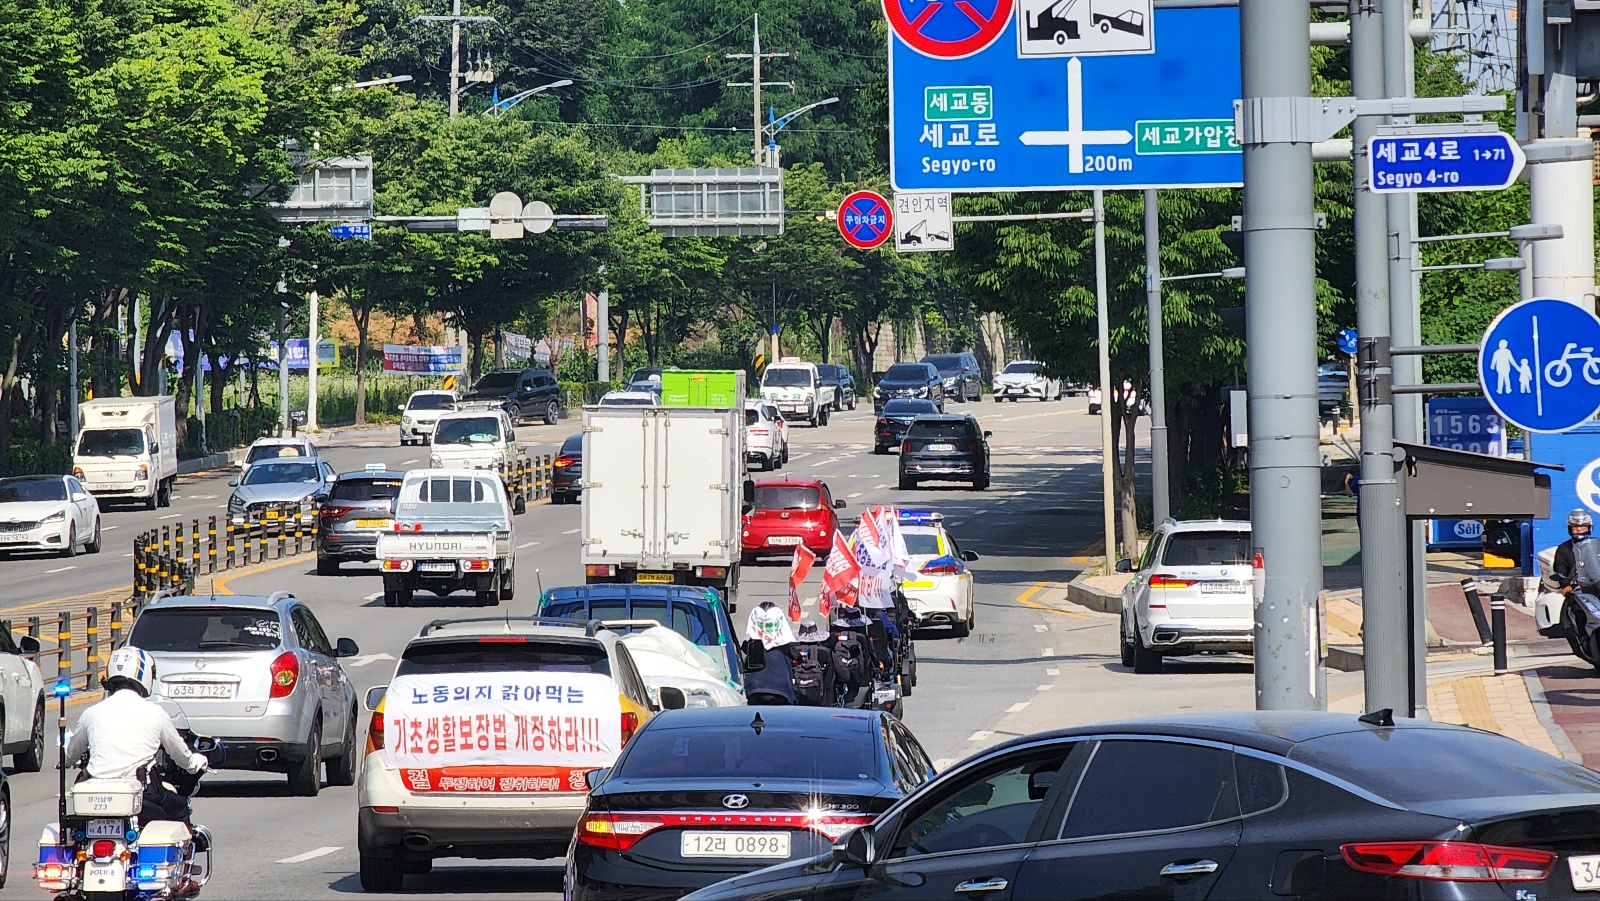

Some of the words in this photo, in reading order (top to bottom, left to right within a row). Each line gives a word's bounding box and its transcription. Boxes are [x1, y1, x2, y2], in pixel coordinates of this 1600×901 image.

[929, 91, 990, 115] 세교동
[918, 122, 1001, 149] 세교로
[1375, 140, 1462, 164] 세교4로
[921, 156, 997, 176] Segyo-ro
[1084, 155, 1133, 172] 200m
[1377, 170, 1423, 188] Segyo
[1426, 168, 1460, 184] 4-ro
[898, 195, 949, 214] 견인지역
[845, 214, 886, 226] 주정차금지
[1433, 414, 1499, 435] 1563
[1457, 523, 1481, 535] Self
[409, 542, 462, 550] HYUNDAI
[200, 686, 226, 695] 7122
[411, 685, 492, 704] 노동의지
[502, 685, 584, 704] 갉아먹는
[393, 714, 507, 754] 기초생활보장법
[514, 715, 600, 753] 개정하라!!!
[97, 826, 120, 834] 4174
[735, 837, 779, 852] 0898
[1516, 890, 1536, 901] K5
